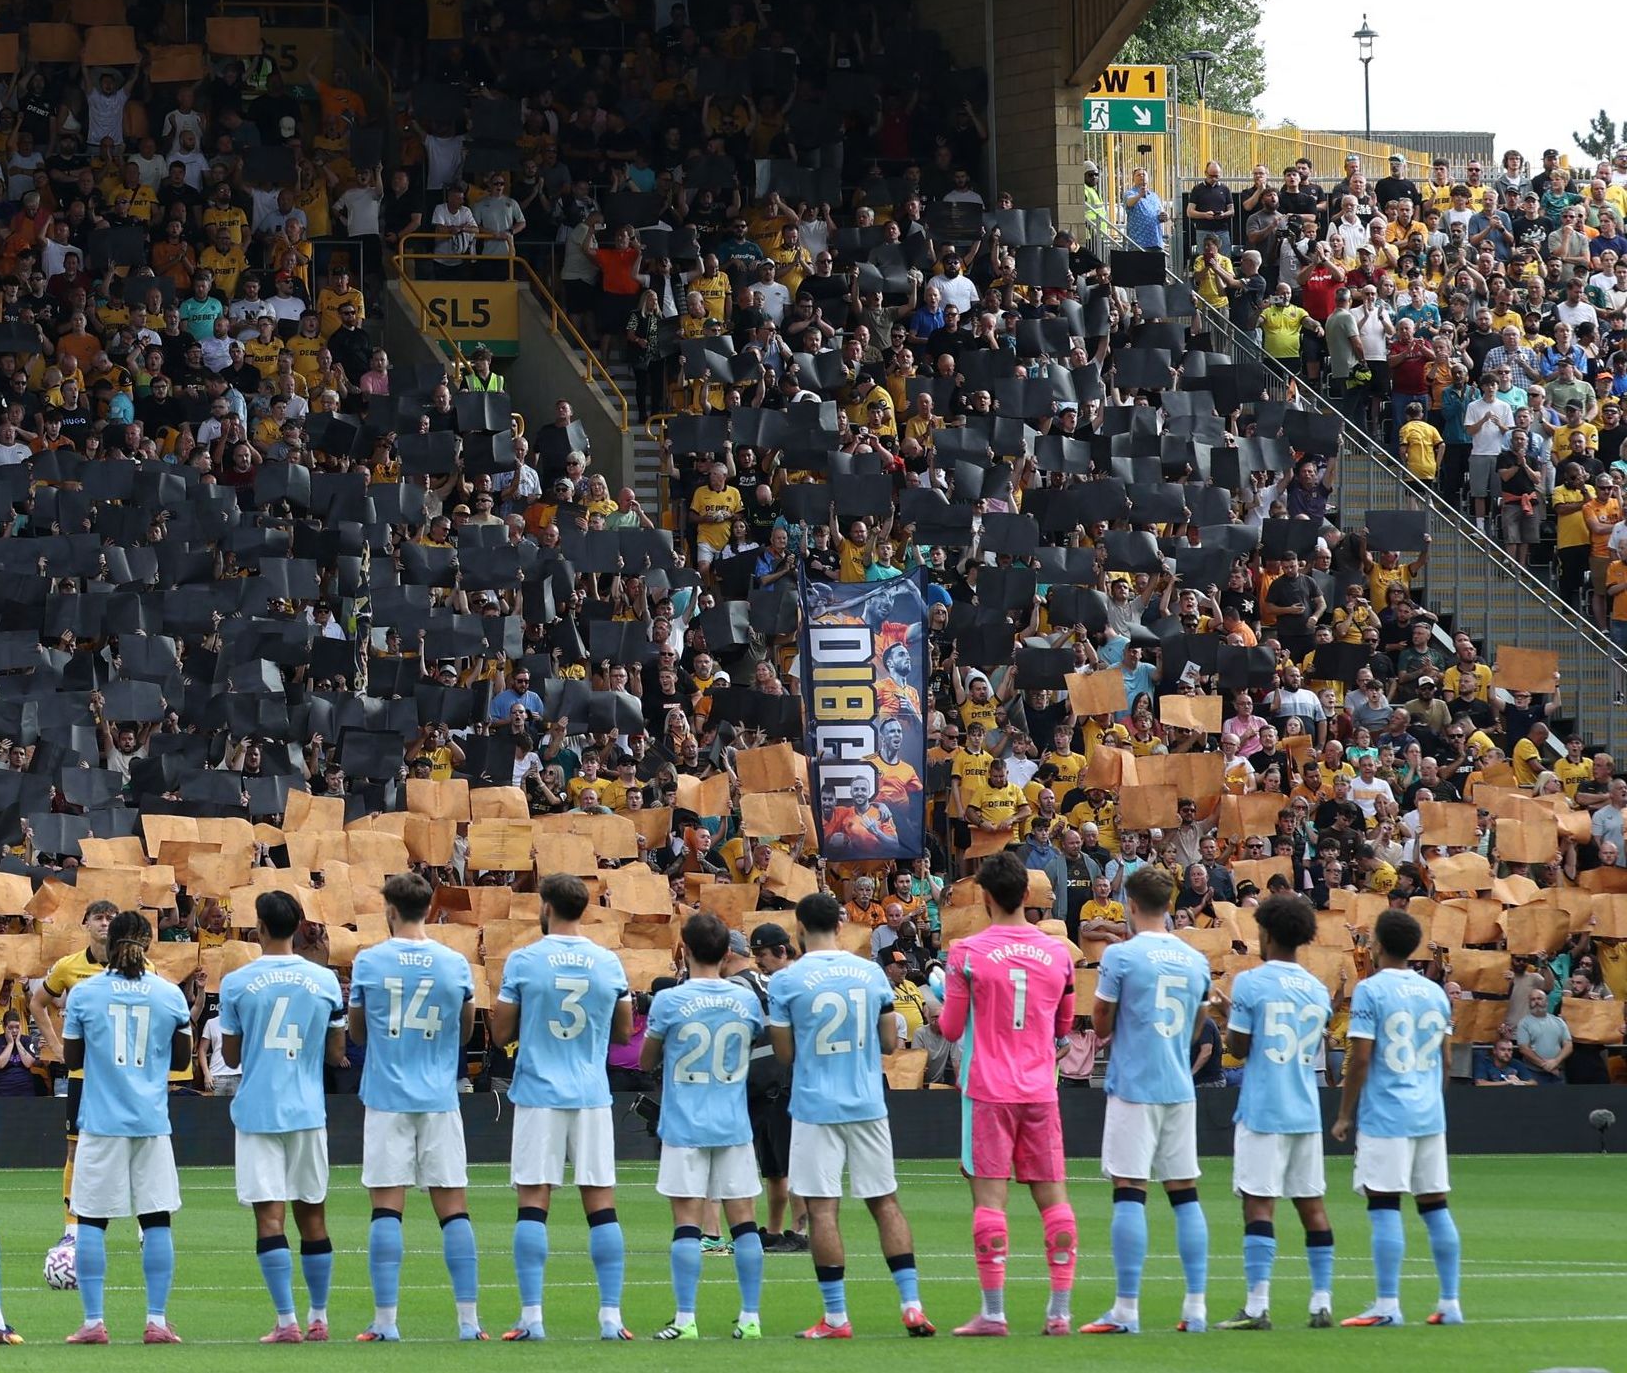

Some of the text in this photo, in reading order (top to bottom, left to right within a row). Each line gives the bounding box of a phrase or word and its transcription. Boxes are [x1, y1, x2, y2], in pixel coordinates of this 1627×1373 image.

[1144, 70, 1155, 92] 1
[26, 104, 51, 117] DEBET
[214, 266, 237, 275] DEBET
[192, 313, 217, 322] DEBET
[429, 297, 491, 328] SL5
[62, 417, 88, 427] HUGO
[705, 504, 731, 514] DEBET
[965, 768, 988, 777] DEBET
[987, 799, 1015, 809] DEBET
[1066, 879, 1092, 888] DEBET
[398, 951, 434, 969] NICO
[985, 942, 1053, 968] TRAFFORD
[1145, 948, 1192, 968] STONES
[111, 980, 152, 996] DOKU
[246, 971, 321, 996] REIJNDERS
[384, 977, 443, 1040] 14
[547, 978, 590, 1041] 3
[679, 996, 749, 1019] BERNARDO
[1008, 967, 1027, 1031] 1
[1154, 974, 1189, 1038] 5
[264, 996, 303, 1060] 4
[810, 987, 868, 1056] 21
[1263, 1000, 1325, 1066] 52
[108, 1002, 151, 1068] 11
[1384, 1009, 1445, 1074] 82
[673, 1021, 750, 1085] 20
